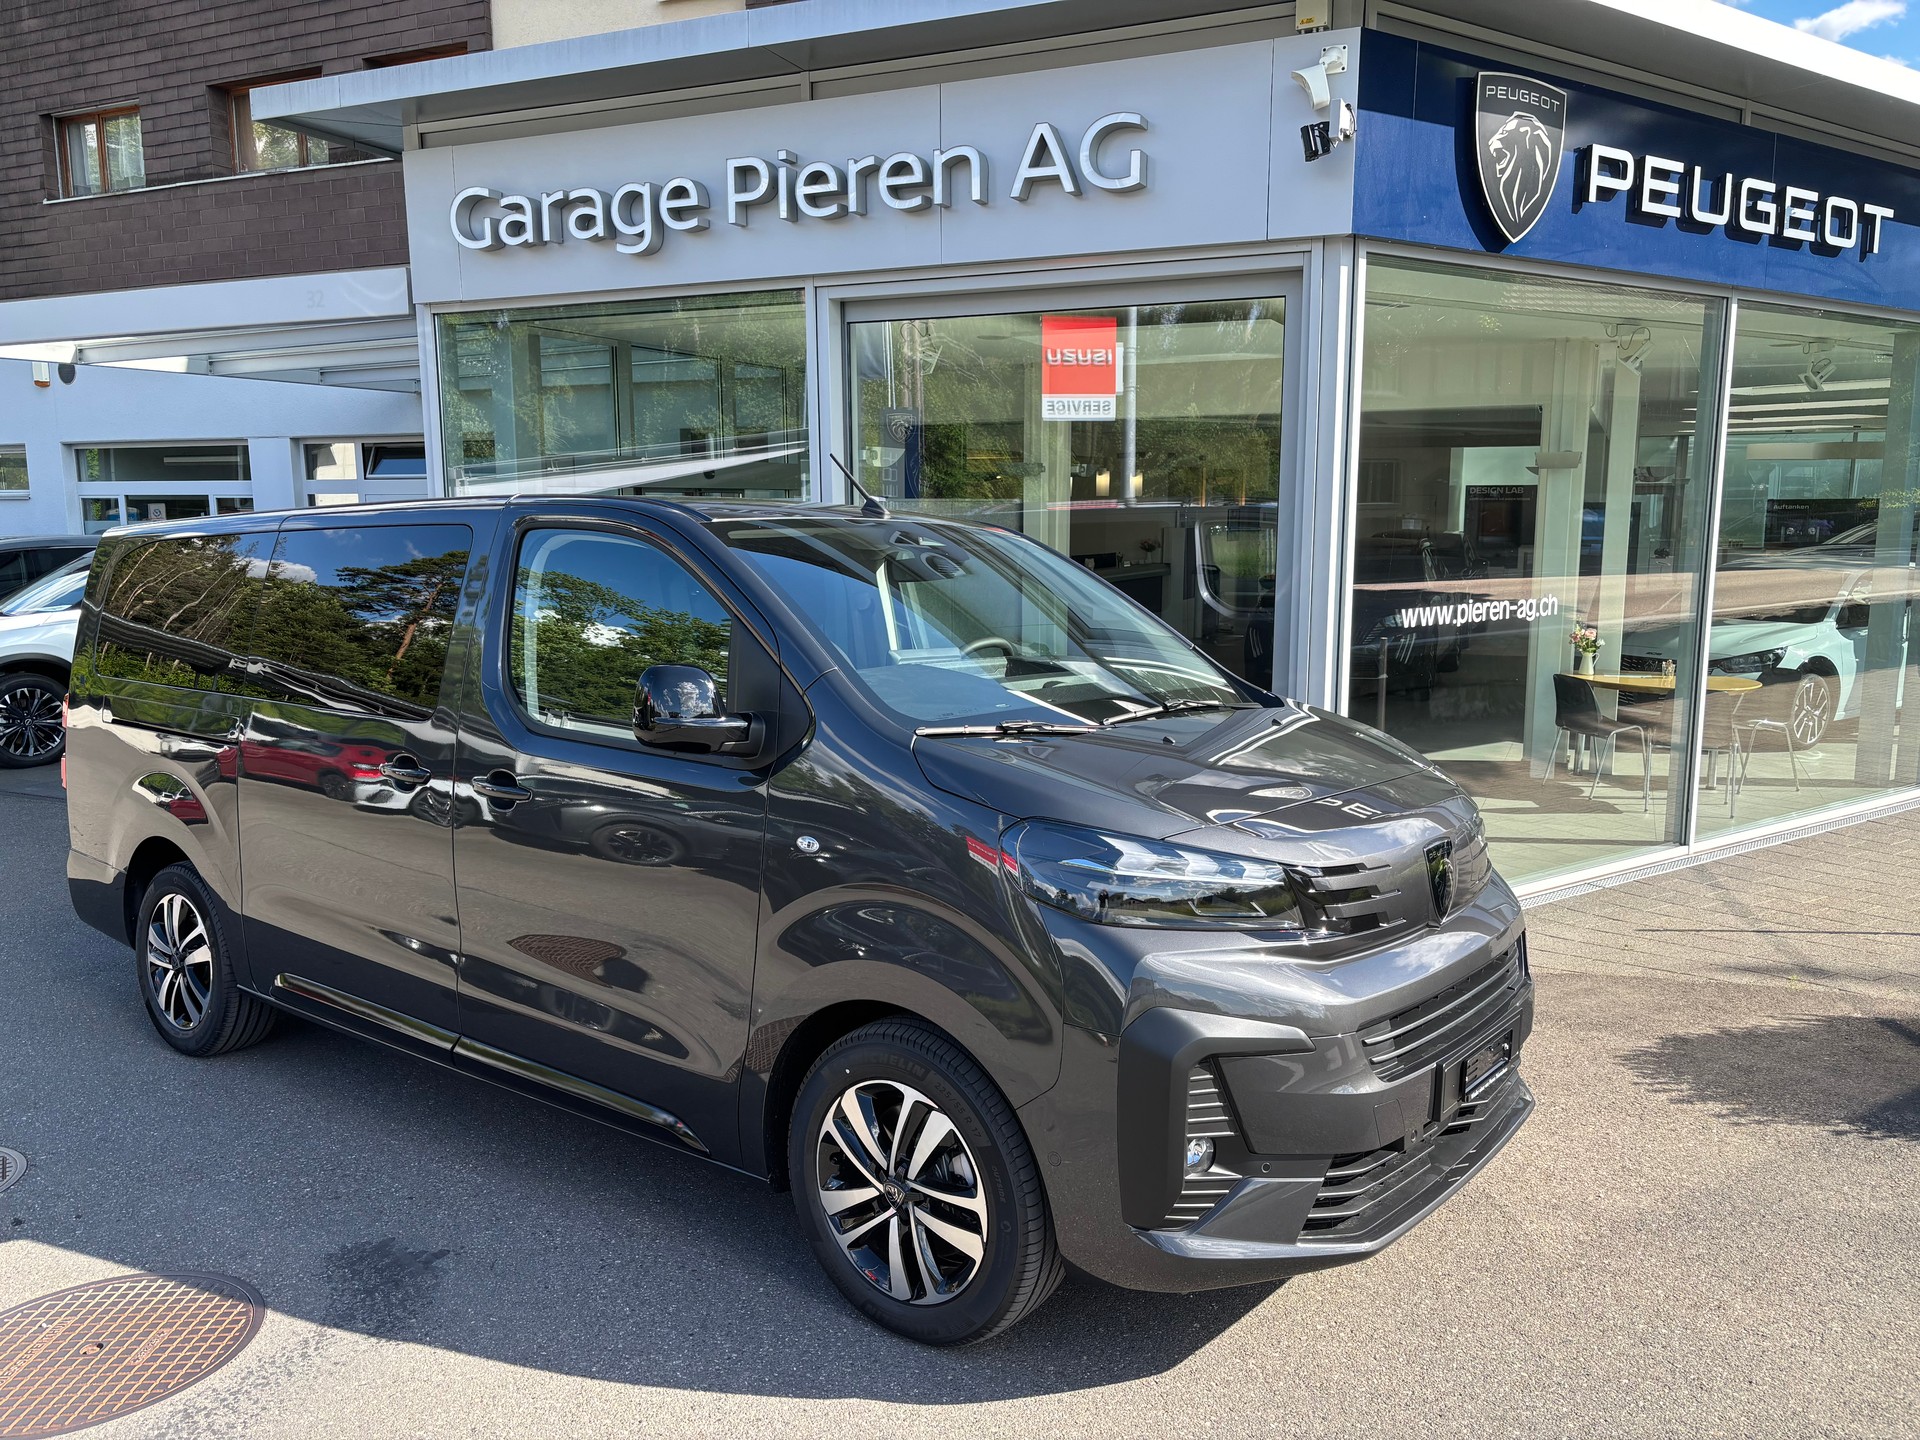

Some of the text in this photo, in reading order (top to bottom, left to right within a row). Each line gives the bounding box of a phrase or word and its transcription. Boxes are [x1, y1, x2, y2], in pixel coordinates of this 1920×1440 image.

[1485, 85, 1560, 112] PEUGEOT
[450, 111, 1148, 256] Garage Pieren AG
[1587, 143, 1895, 255] PEUGEOT
[306, 289, 326, 309] 32
[1469, 486, 1524, 495] DESIGN LAB
[1401, 593, 1558, 629] www.pieren-ag.ch
[934, 1082, 965, 1114] 225/55
